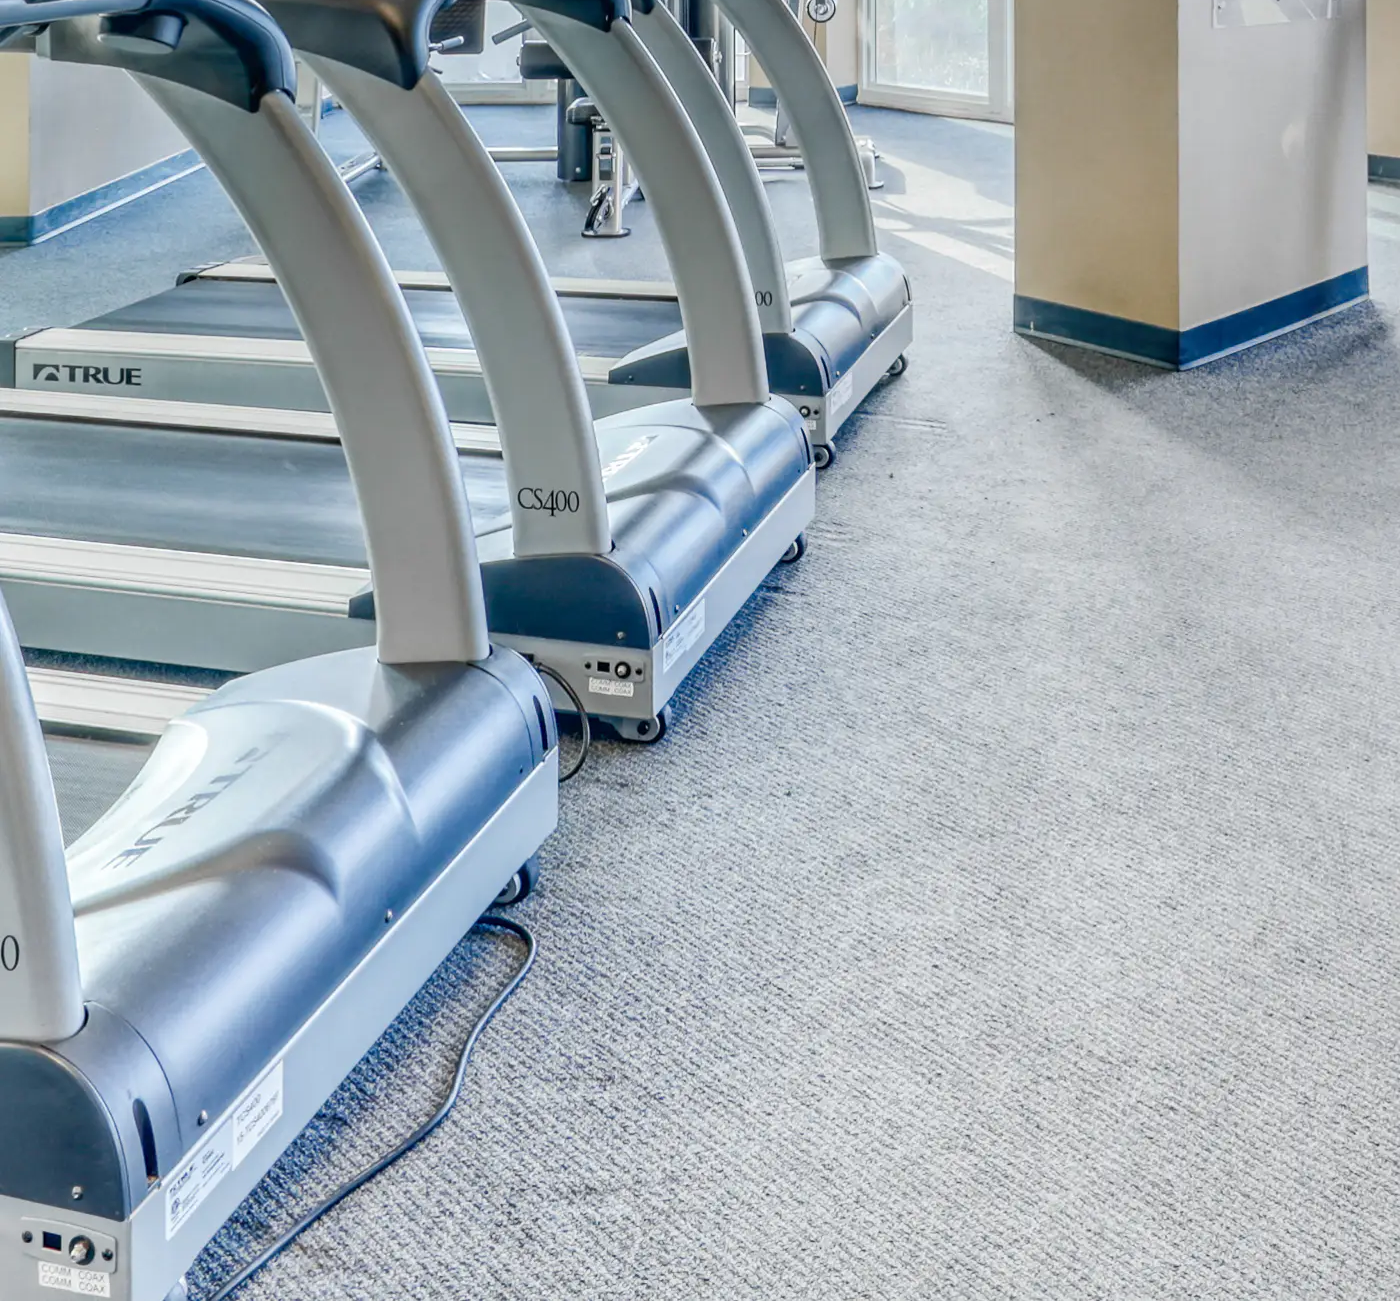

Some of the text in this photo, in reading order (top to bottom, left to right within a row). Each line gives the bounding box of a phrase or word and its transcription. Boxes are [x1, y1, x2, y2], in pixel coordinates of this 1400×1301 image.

[61, 365, 142, 386] TRUE
[517, 487, 580, 517] CS400
[100, 764, 253, 871] TRUE
